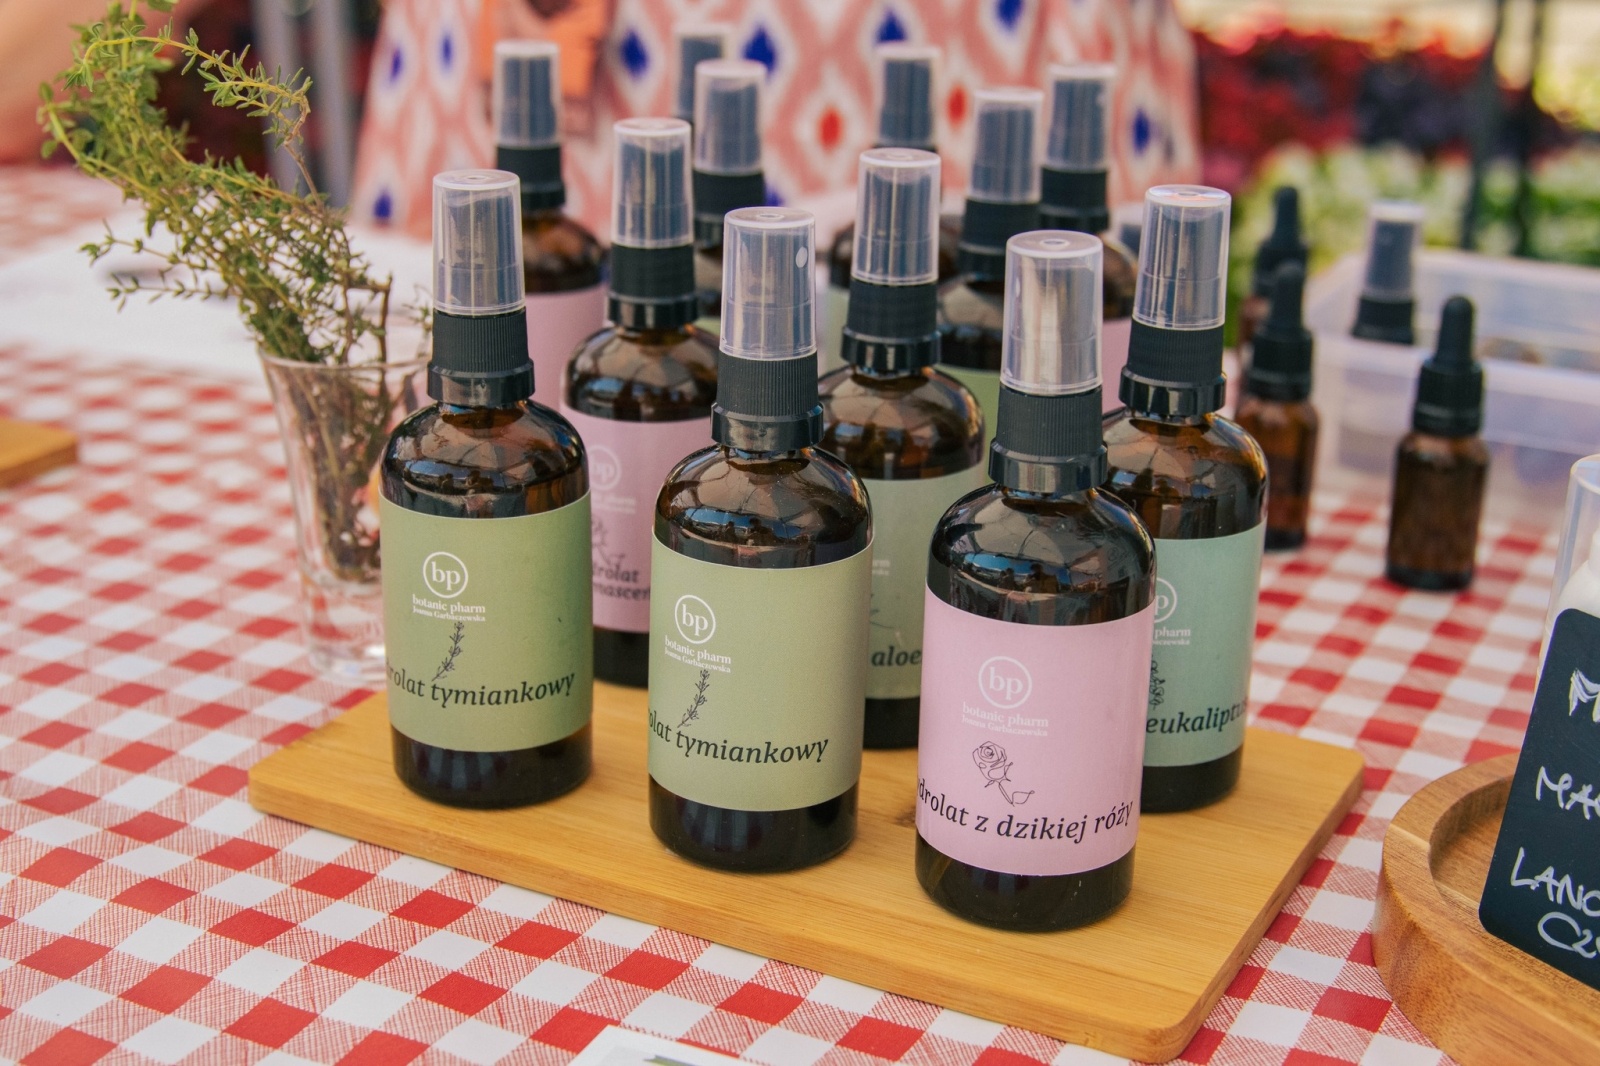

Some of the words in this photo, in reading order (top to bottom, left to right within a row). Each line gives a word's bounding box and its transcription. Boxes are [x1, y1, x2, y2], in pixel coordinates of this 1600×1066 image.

[431, 561, 461, 591] bp
[412, 593, 448, 611] botanic
[450, 601, 486, 615] pharm
[682, 603, 709, 637] bp
[1154, 626, 1191, 640] pharm
[664, 634, 695, 657] botanic
[697, 649, 731, 664] pharm
[430, 672, 575, 709] tymiankowy
[989, 667, 1023, 700] bp
[962, 701, 1004, 723] botanic
[1007, 713, 1049, 728] pharm
[648, 709, 672, 743] olat
[676, 731, 829, 764] tymiankowy
[918, 777, 969, 826] drolat
[974, 813, 990, 833] z
[996, 814, 1087, 844] dzikiej
[1094, 800, 1133, 834] róży
